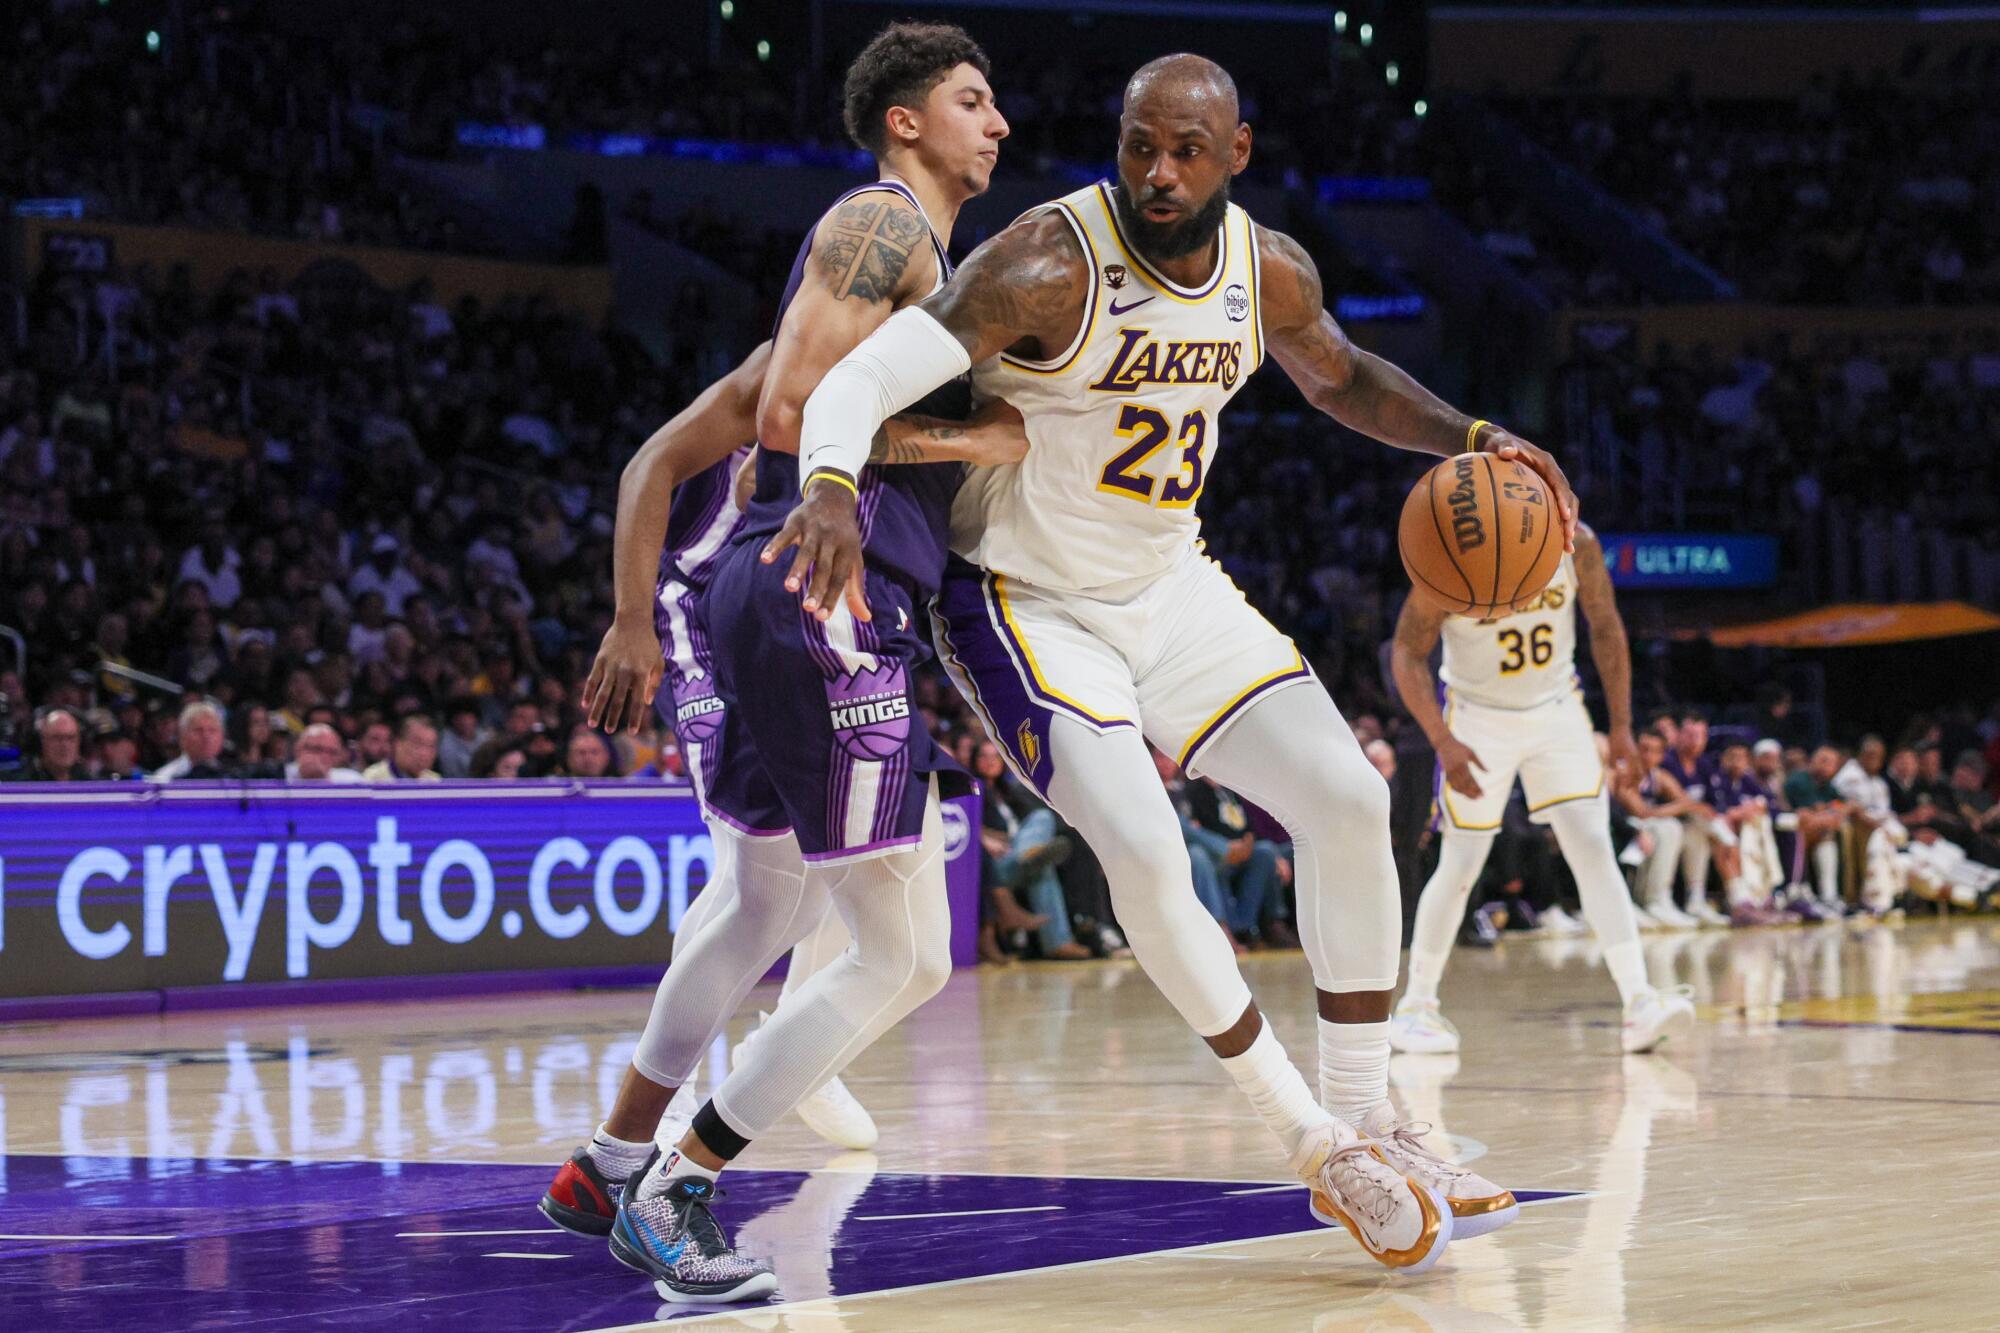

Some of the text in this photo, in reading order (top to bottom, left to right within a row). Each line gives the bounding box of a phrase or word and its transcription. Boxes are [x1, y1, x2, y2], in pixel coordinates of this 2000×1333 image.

[1226, 294, 1248, 311] bibigo
[1089, 327, 1242, 392] LAKERS
[1095, 401, 1206, 509] 23
[1447, 455, 1486, 554] Wilson
[1636, 546, 1731, 574] ULTRA
[1498, 623, 1553, 673] 36
[677, 696, 725, 722] KINGS
[830, 697, 910, 730] KINGS
[831, 689, 904, 707] SACRAMENTO
